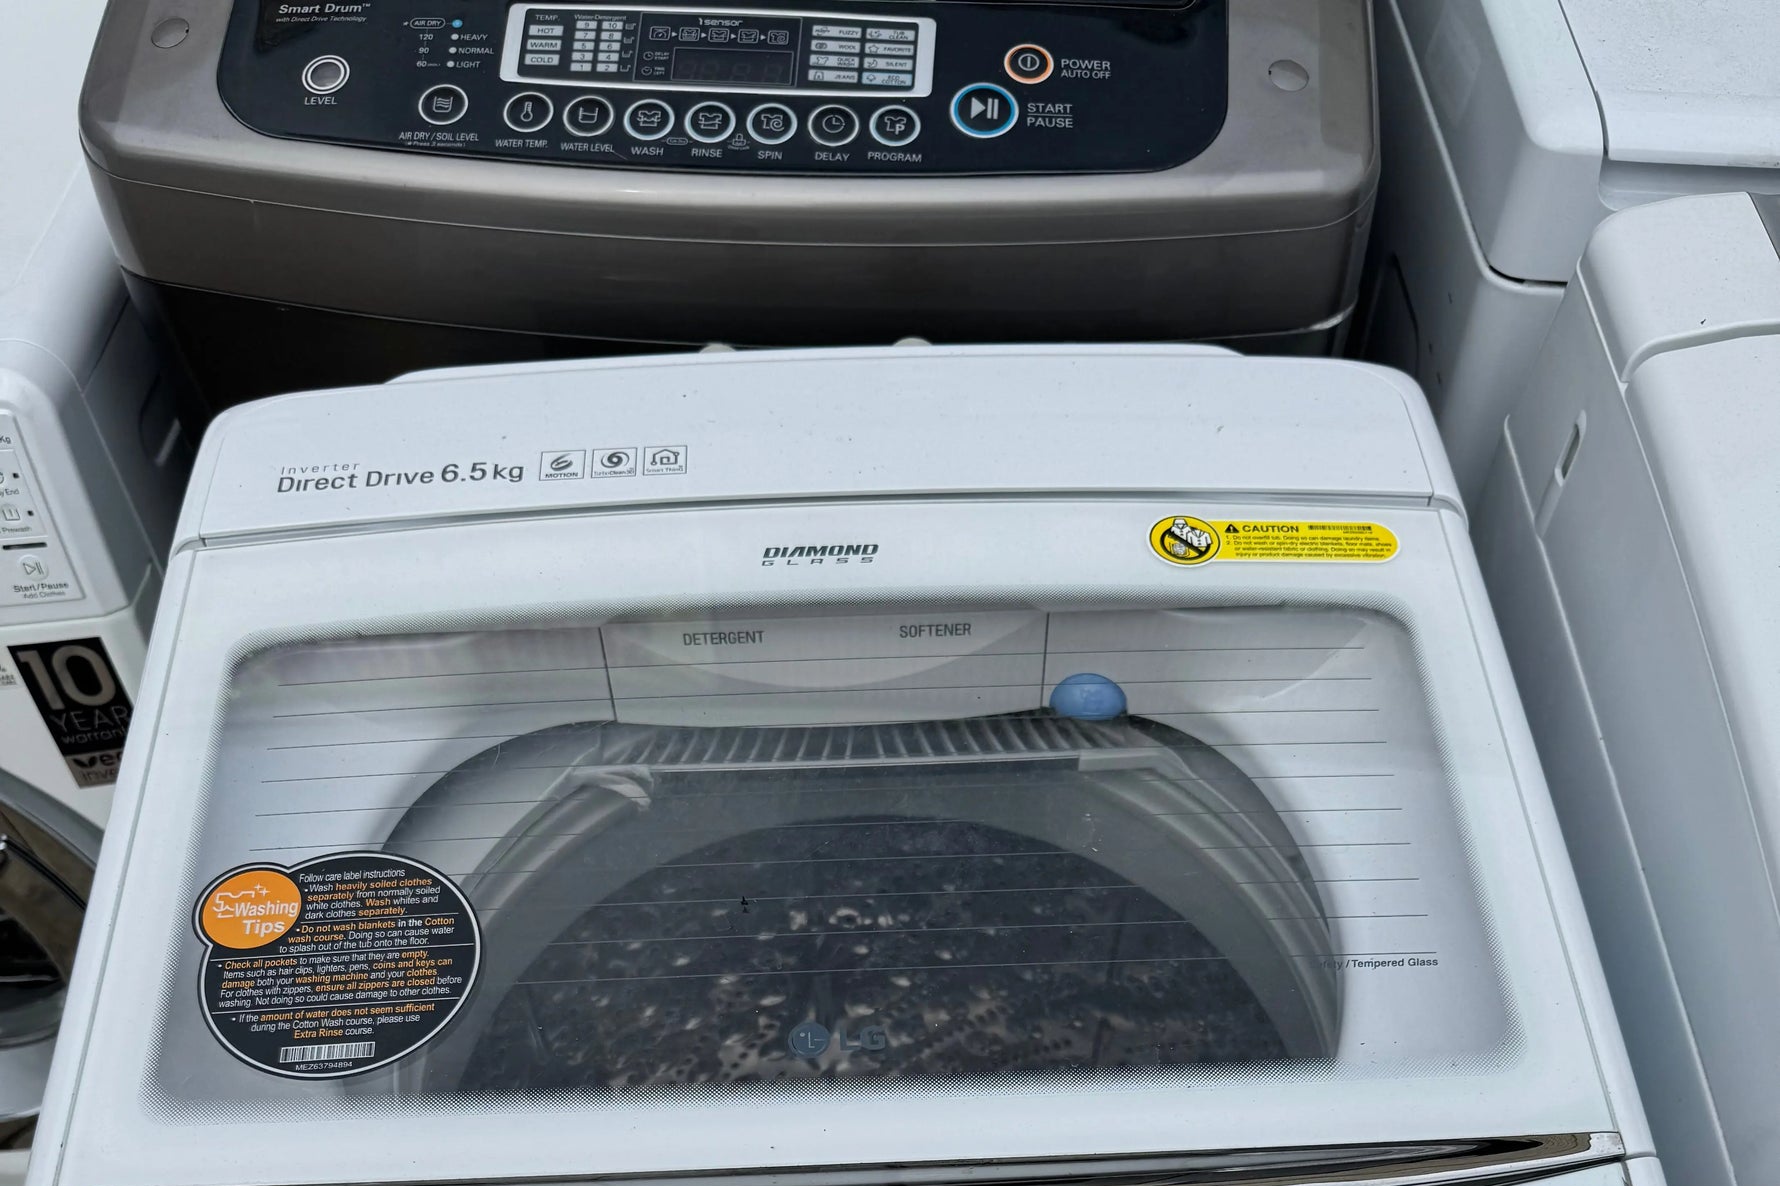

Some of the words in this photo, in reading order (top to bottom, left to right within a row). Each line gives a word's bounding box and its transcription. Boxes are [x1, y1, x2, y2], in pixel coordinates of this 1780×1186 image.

[279, 4, 321, 14] Smart
[460, 33, 488, 41] HEAVY
[459, 46, 494, 55] NORMAL
[456, 60, 480, 69] LIGHT
[1061, 59, 1111, 70] POWER
[1060, 70, 1091, 79] AUTO
[1092, 70, 1111, 80] OFF
[304, 96, 337, 106] LEVEL
[1027, 103, 1073, 114] START
[1027, 117, 1073, 129] PAUSE
[495, 140, 523, 148] WATER
[524, 139, 548, 148] TEMP.
[560, 143, 589, 152] WATER
[590, 143, 615, 153] LEVEL
[631, 146, 664, 156] WASH
[691, 147, 723, 160] RINSE
[757, 150, 784, 162] SPIN
[815, 151, 850, 163] DELAY
[868, 151, 922, 164] PROGRAM
[281, 461, 360, 476] Inverter
[277, 473, 358, 494] Direct
[365, 470, 434, 488] Drive
[1242, 525, 1299, 533] CAUTION
[762, 544, 879, 559] DIAMOND
[761, 557, 874, 567] GLASS
[899, 623, 972, 639] SOFTENER
[683, 630, 765, 646] DETERGENT
[16, 645, 116, 710] 10
[299, 873, 324, 883] Follow
[325, 872, 342, 882] care
[343, 870, 362, 881] label
[363, 868, 406, 879] instructions
[309, 883, 334, 893] Wash
[335, 881, 368, 892] heavily
[369, 880, 397, 889] soiled
[399, 878, 433, 887] clothes
[307, 891, 355, 904] separately
[356, 891, 377, 899] from
[377, 888, 414, 898] normally
[415, 885, 441, 896] soiled
[234, 900, 299, 918] Washing
[306, 902, 329, 911] white
[365, 898, 391, 907] Wash
[393, 897, 421, 906] whites
[422, 895, 439, 904] and
[304, 911, 324, 920] dark
[325, 909, 356, 918] clothes
[242, 919, 285, 938] Tips
[1351, 958, 1405, 970] Tempered
[1407, 958, 1439, 967] Glass
[238, 1014, 246, 1023] If
[246, 1013, 259, 1022] the
[260, 1010, 294, 1022] amount
[295, 1009, 305, 1019] of
[305, 1009, 330, 1018] water
[331, 1007, 352, 1016] does
[354, 1006, 369, 1015] not
[370, 1005, 394, 1014] seem
[395, 1002, 436, 1013] sufficient
[293, 1029, 318, 1039] Extra
[318, 1027, 344, 1038] Rinse
[839, 1025, 886, 1051] LG
